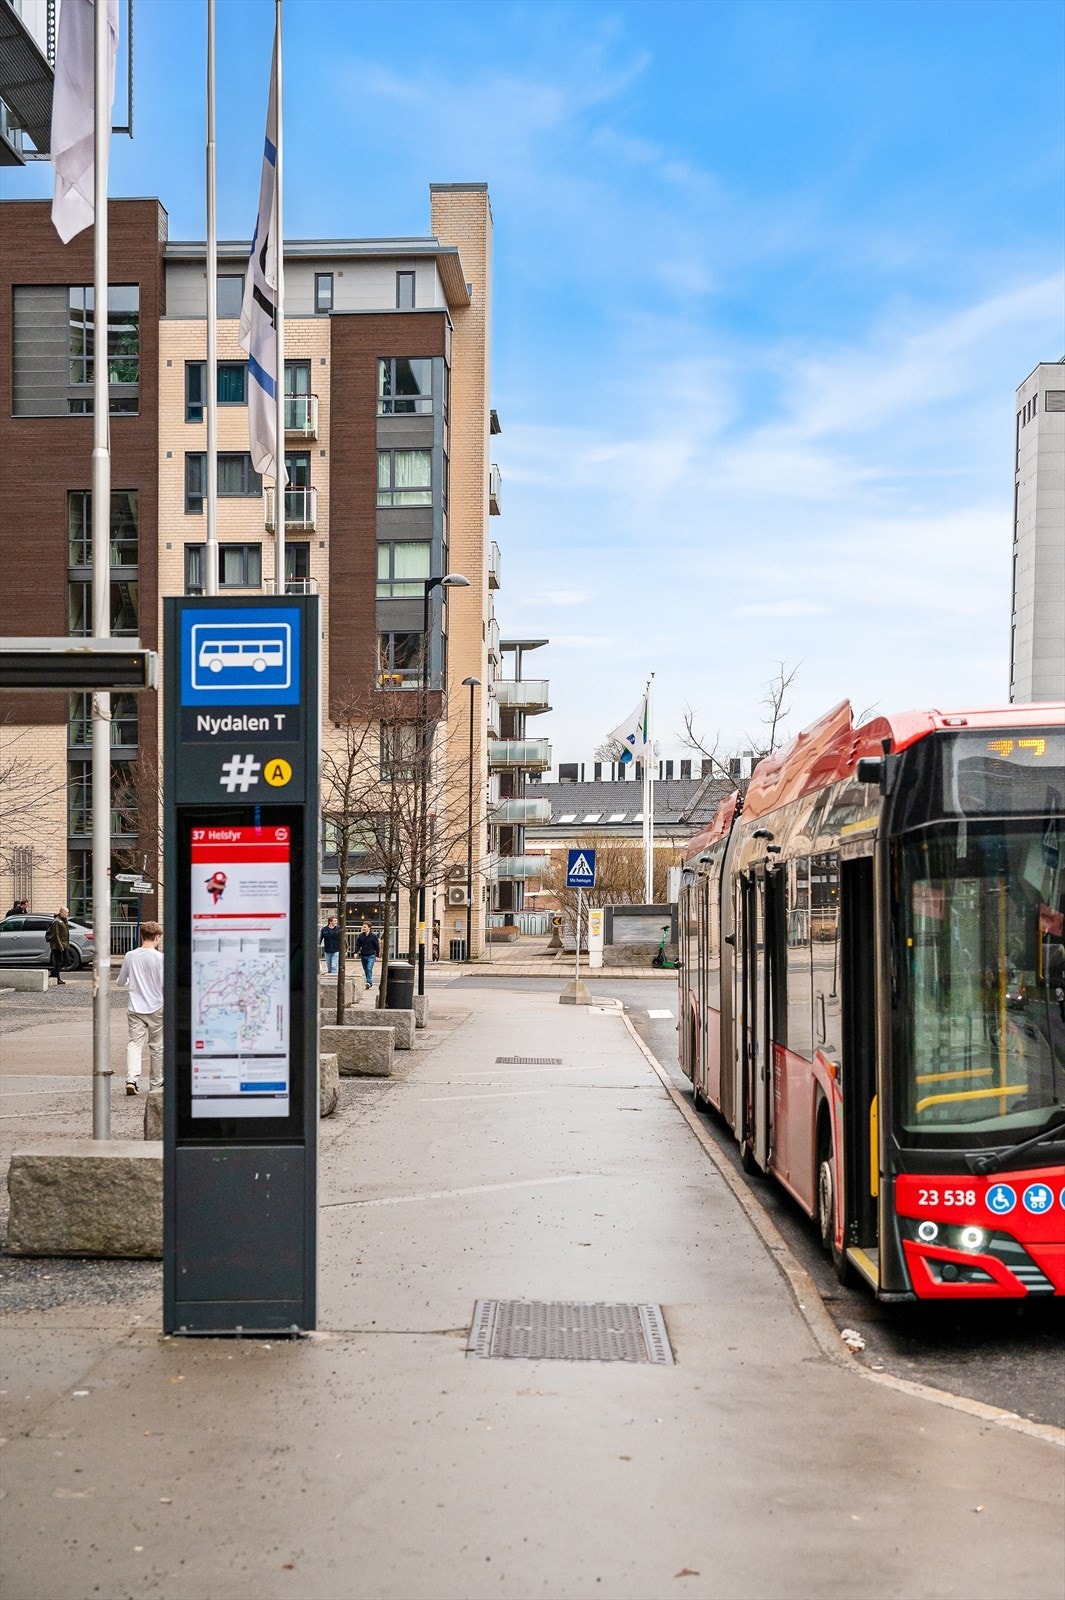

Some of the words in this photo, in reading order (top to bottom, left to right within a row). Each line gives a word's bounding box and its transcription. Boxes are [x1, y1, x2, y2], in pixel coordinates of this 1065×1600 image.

[197, 714, 270, 735] Nydalen
[273, 714, 286, 730] T
[192, 830, 205, 841] 37
[208, 830, 242, 842] Helsfyr
[918, 1189, 939, 1205] 23
[943, 1189, 976, 1206] 538
